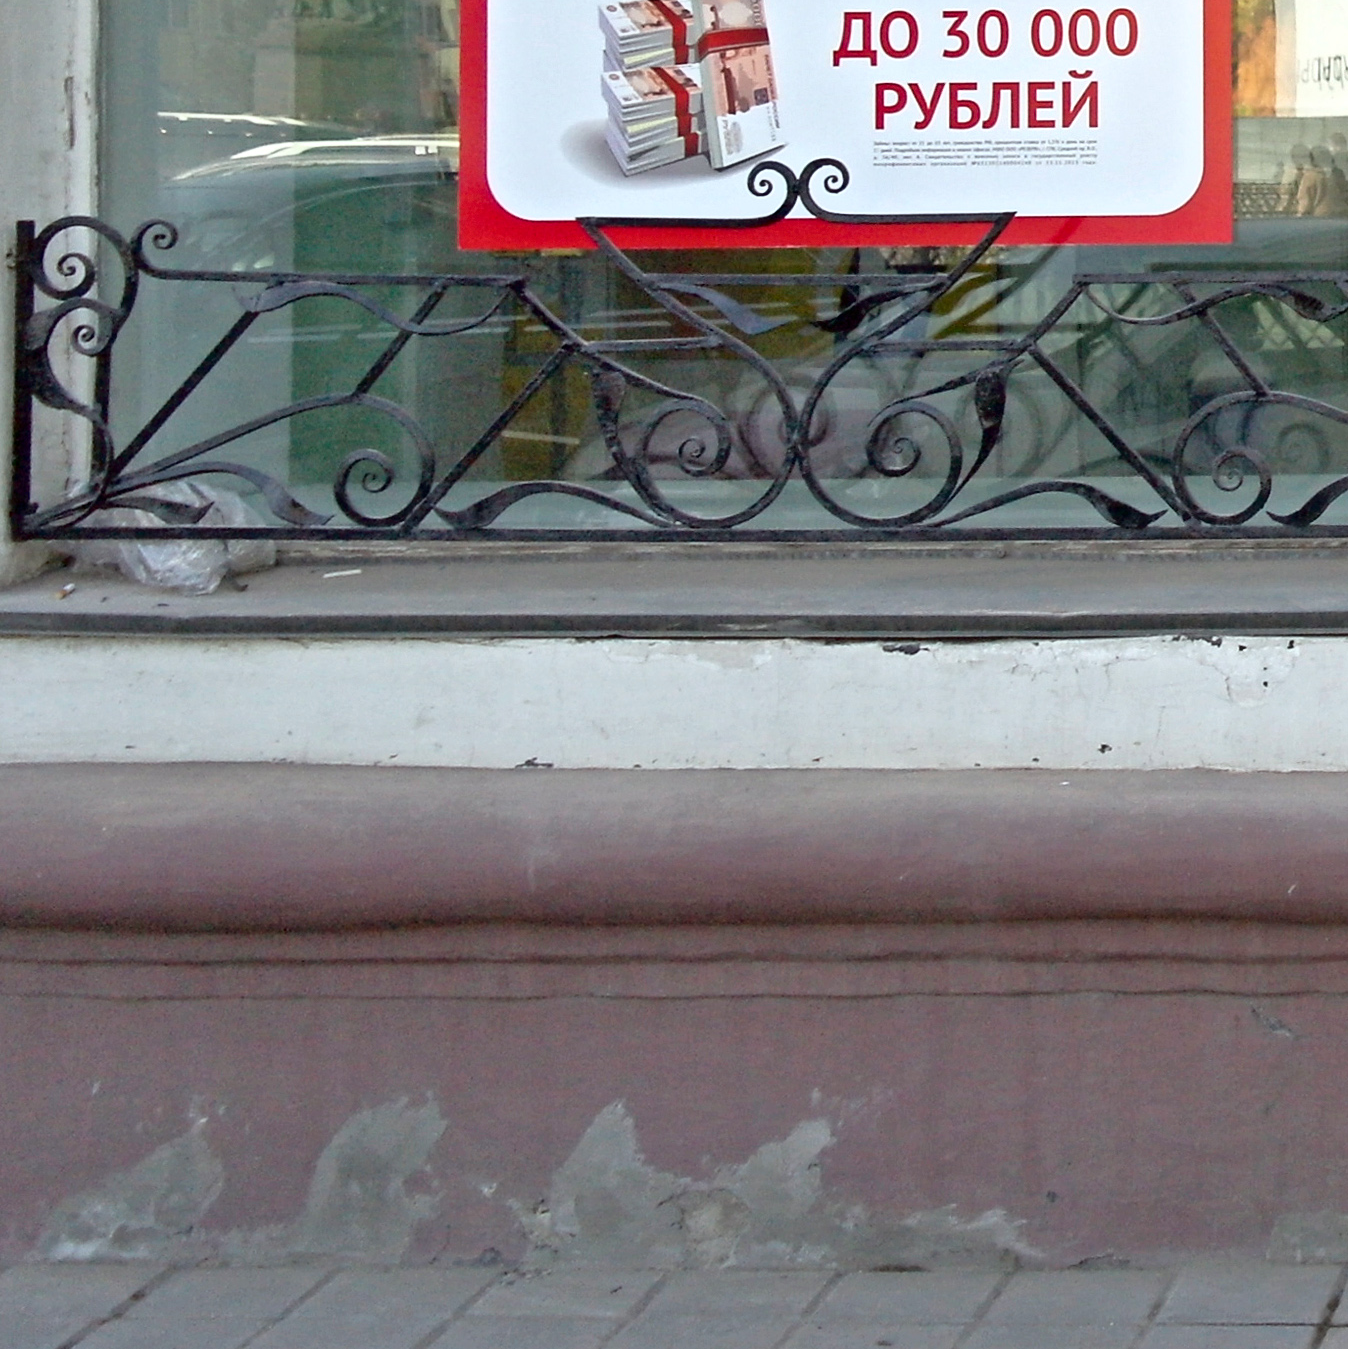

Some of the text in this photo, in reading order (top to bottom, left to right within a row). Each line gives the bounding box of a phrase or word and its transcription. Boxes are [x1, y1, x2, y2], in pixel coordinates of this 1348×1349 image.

[833, 8, 1138, 67] ДО 30 000
[875, 70, 1098, 130] РУБЛЕЙ
